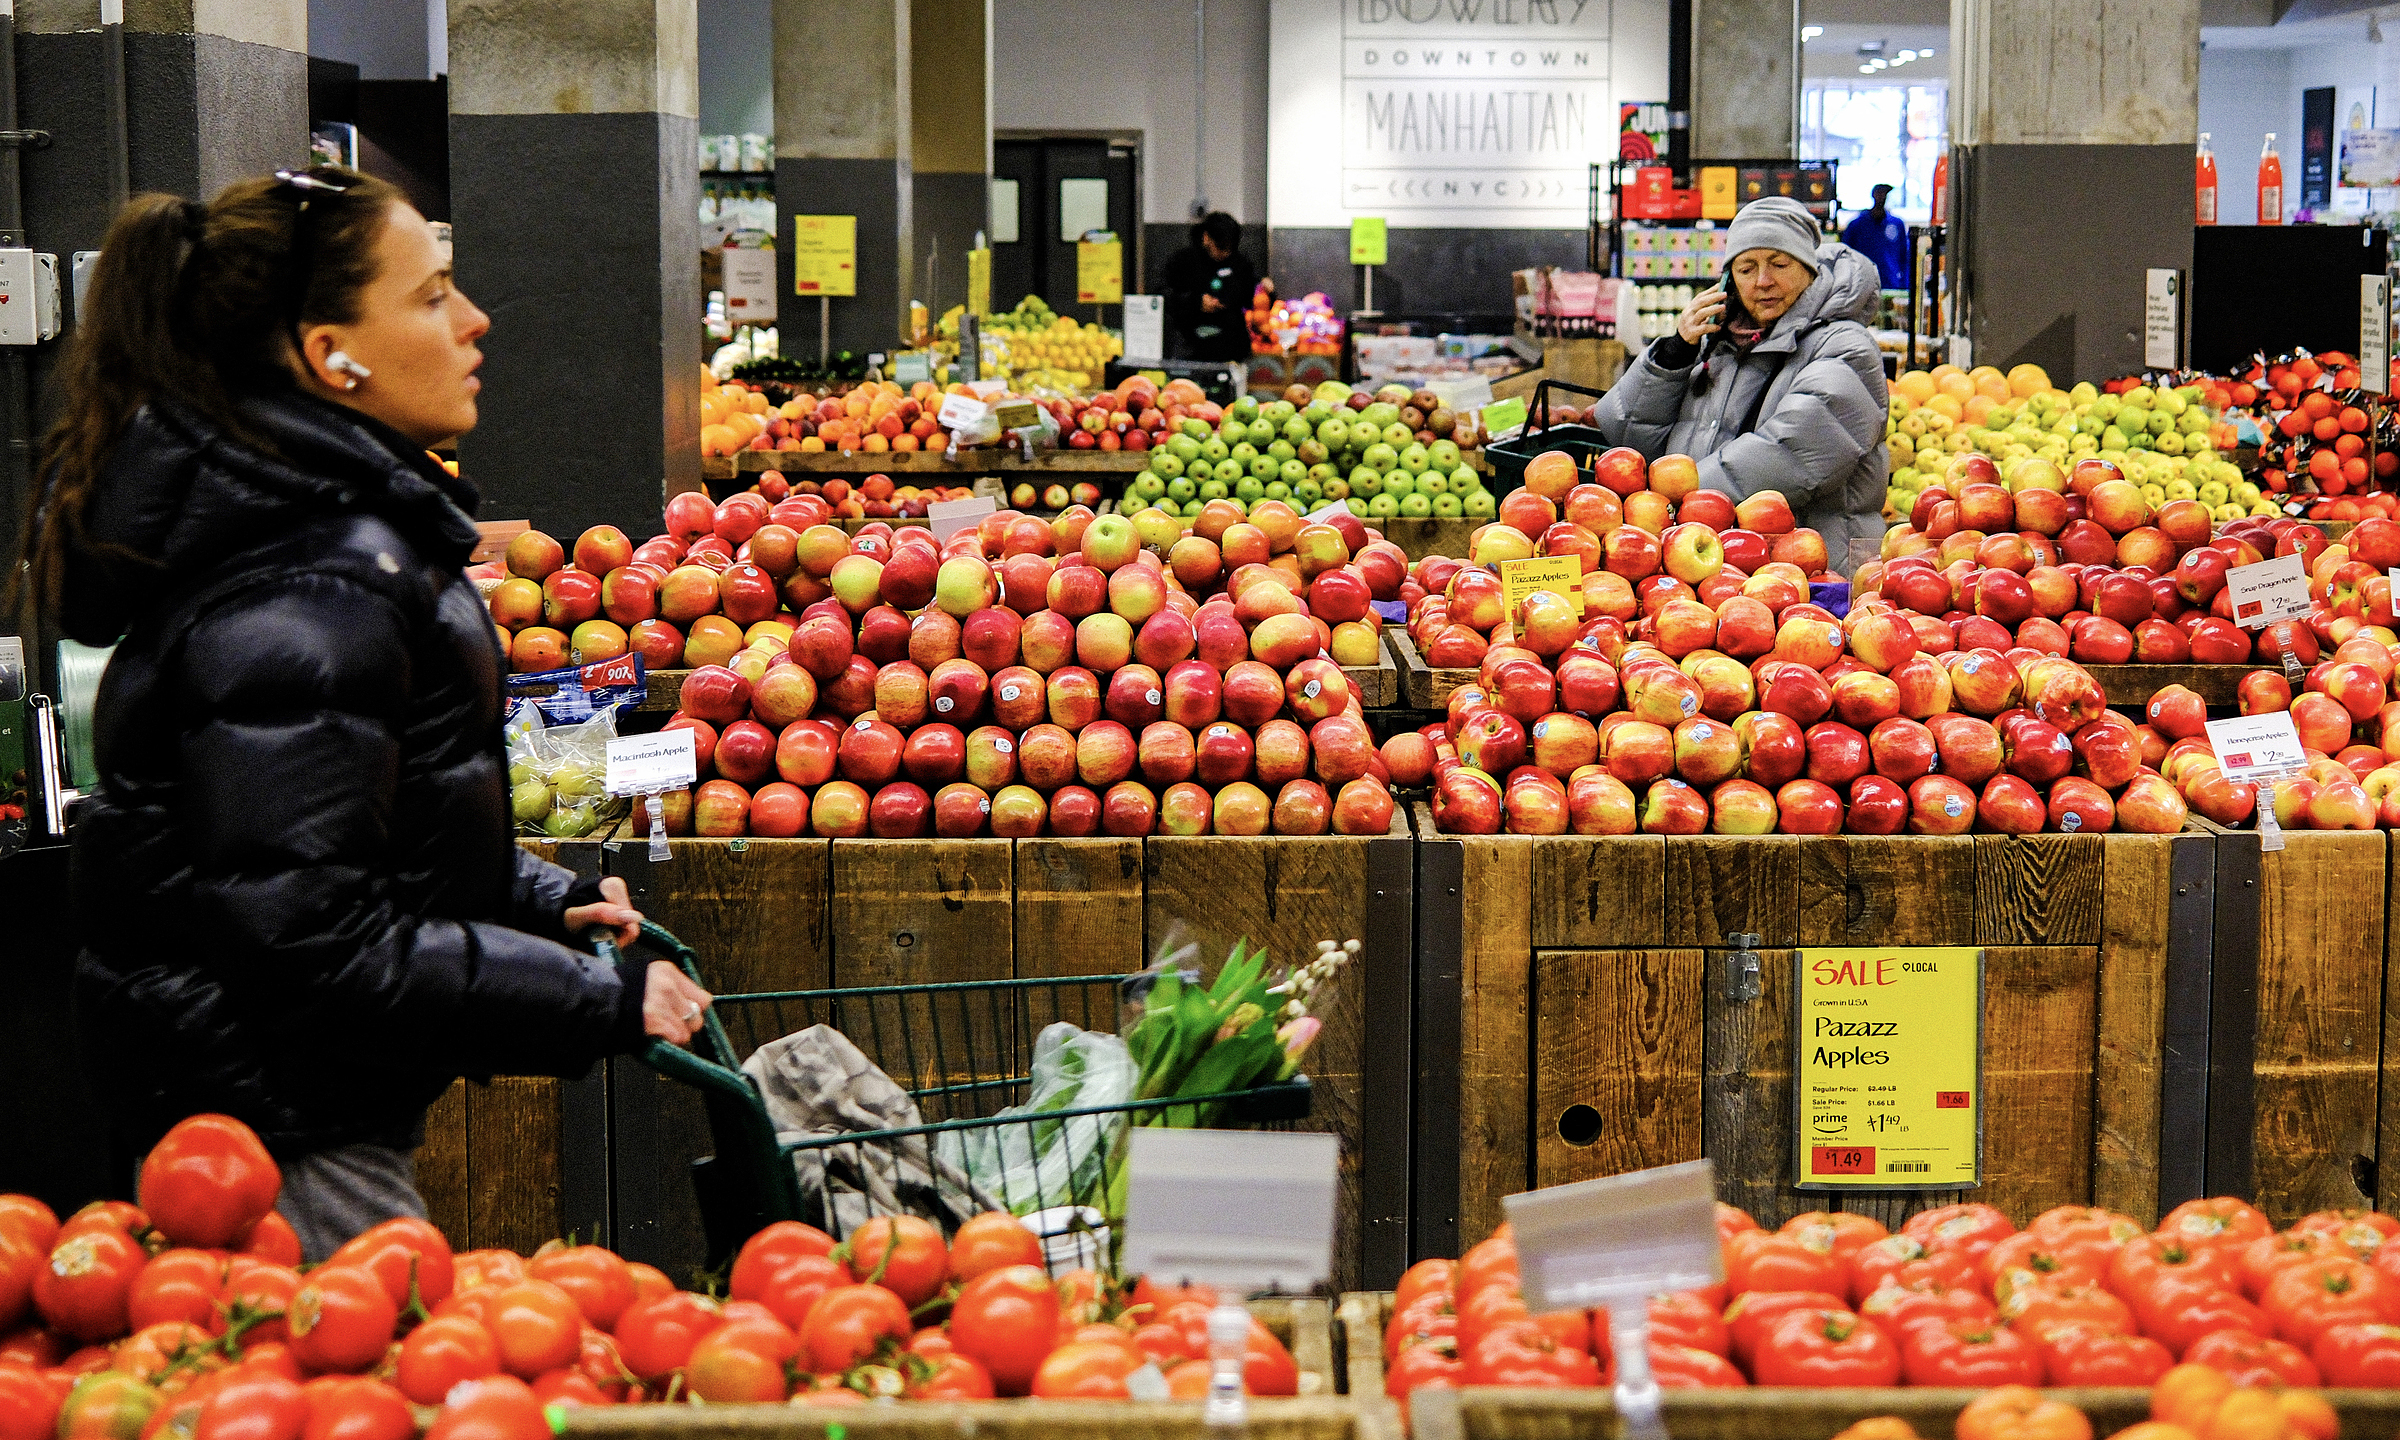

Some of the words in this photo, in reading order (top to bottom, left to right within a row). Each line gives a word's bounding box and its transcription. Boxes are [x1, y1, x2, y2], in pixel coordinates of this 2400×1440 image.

[1364, 50, 1589, 66] DOWNTOWN
[1365, 90, 1585, 152] MANHATTAN
[1443, 181, 1508, 196] NYC
[1506, 562, 1529, 572] SALE
[1511, 575, 1541, 584] Pazazz
[1542, 572, 1570, 582] Apples
[2241, 586, 2258, 594] Snap
[2258, 580, 2282, 589] Dragon
[2282, 575, 2298, 583] Apple
[2226, 735, 2266, 745] Honeycrisp
[2265, 731, 2289, 740] Apples
[612, 750, 662, 763] Macintosh
[662, 746, 689, 756] Apple
[1812, 957, 1898, 987] SALE
[1911, 962, 1938, 973] LOCAL
[1813, 998, 1839, 1007] Grown
[1815, 1017, 1899, 1037] Pazazz
[1813, 1046, 1890, 1069] Apples
[1813, 1112, 1848, 1125] prime
[1825, 1151, 1862, 1167] $1.49
